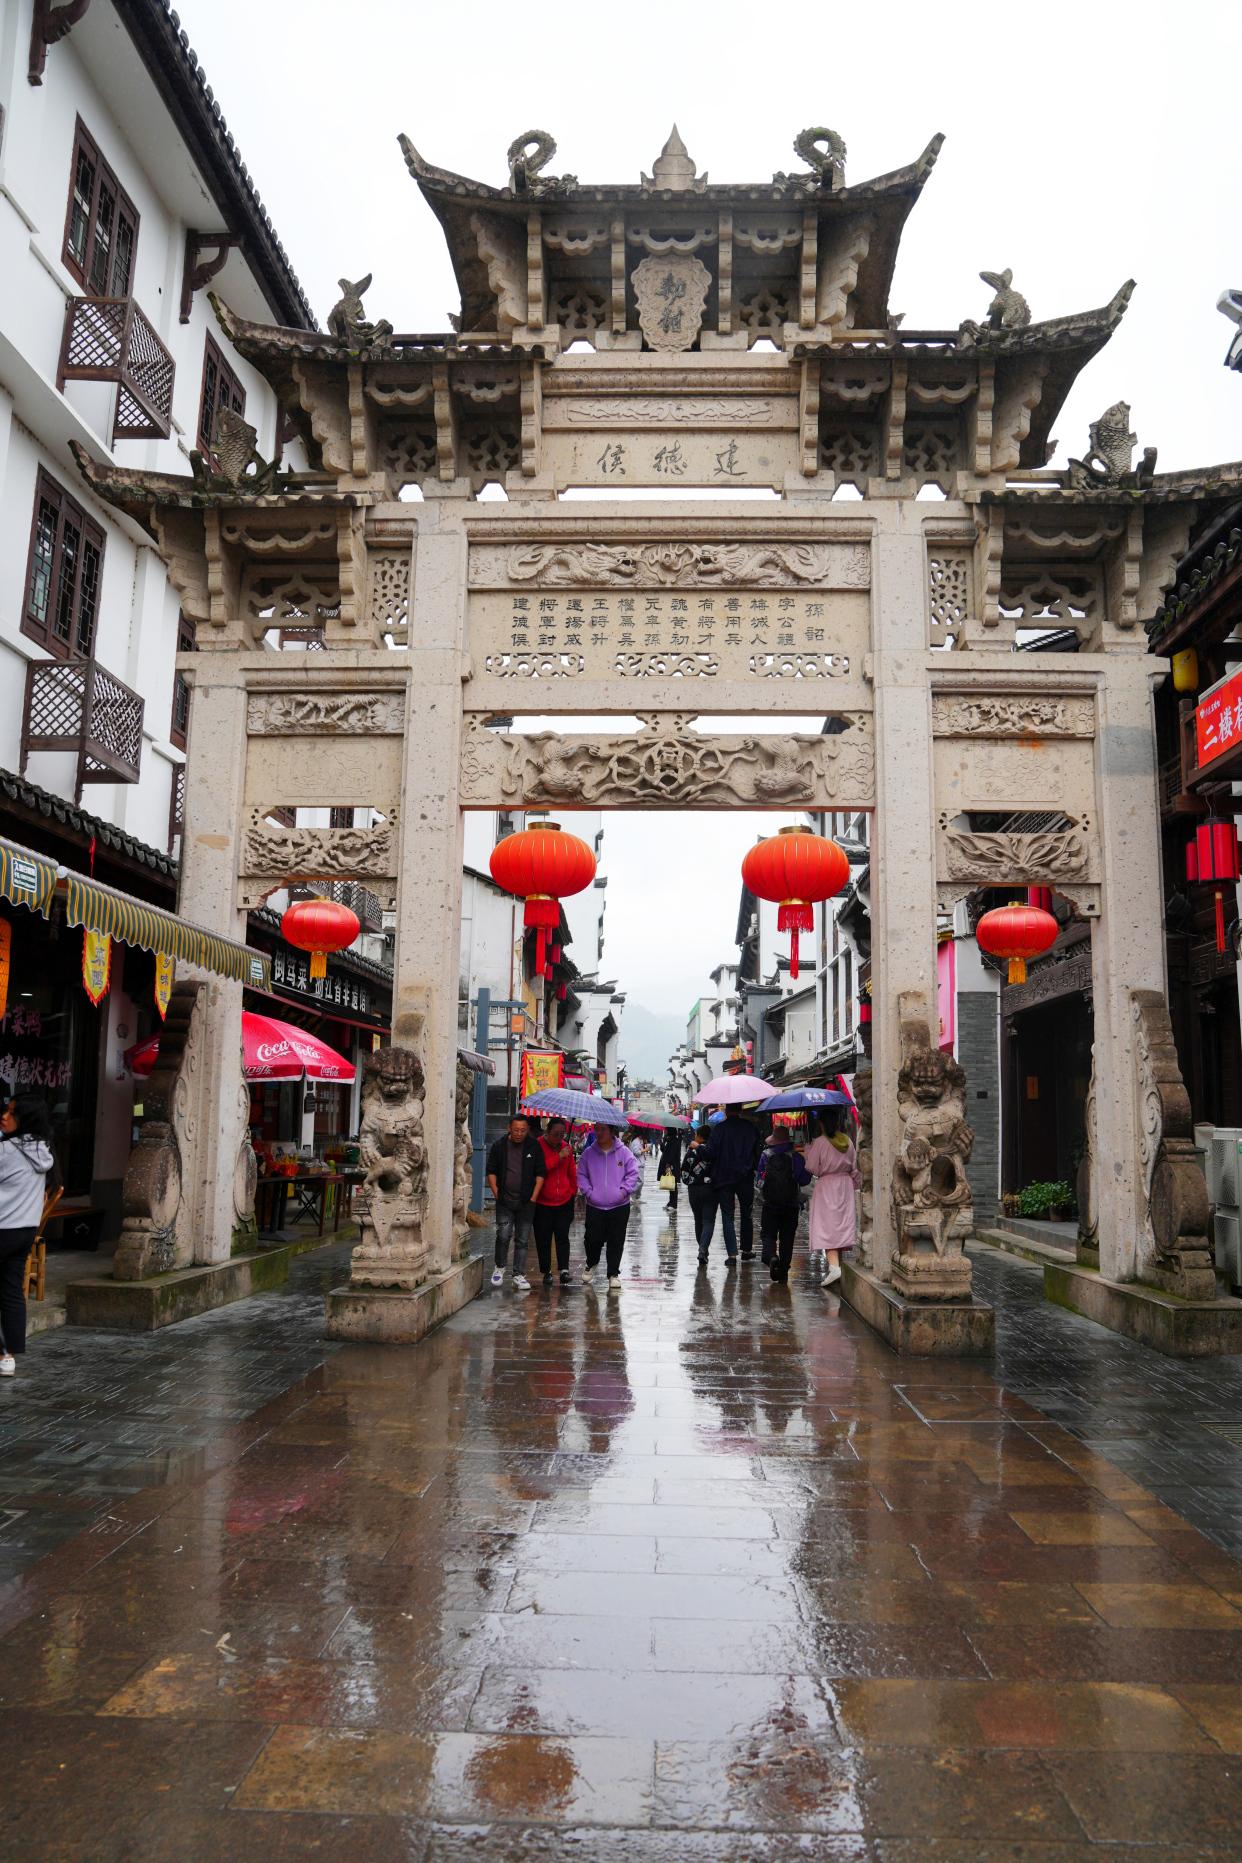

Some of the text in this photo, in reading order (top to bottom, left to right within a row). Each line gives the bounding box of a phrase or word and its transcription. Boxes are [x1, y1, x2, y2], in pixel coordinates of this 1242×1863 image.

[511, 597, 531, 646] 建德侯
[537, 597, 559, 646] 將軍封
[698, 597, 716, 646] 有將才
[724, 597, 743, 646] 善用兵
[750, 597, 770, 646] 梅城人
